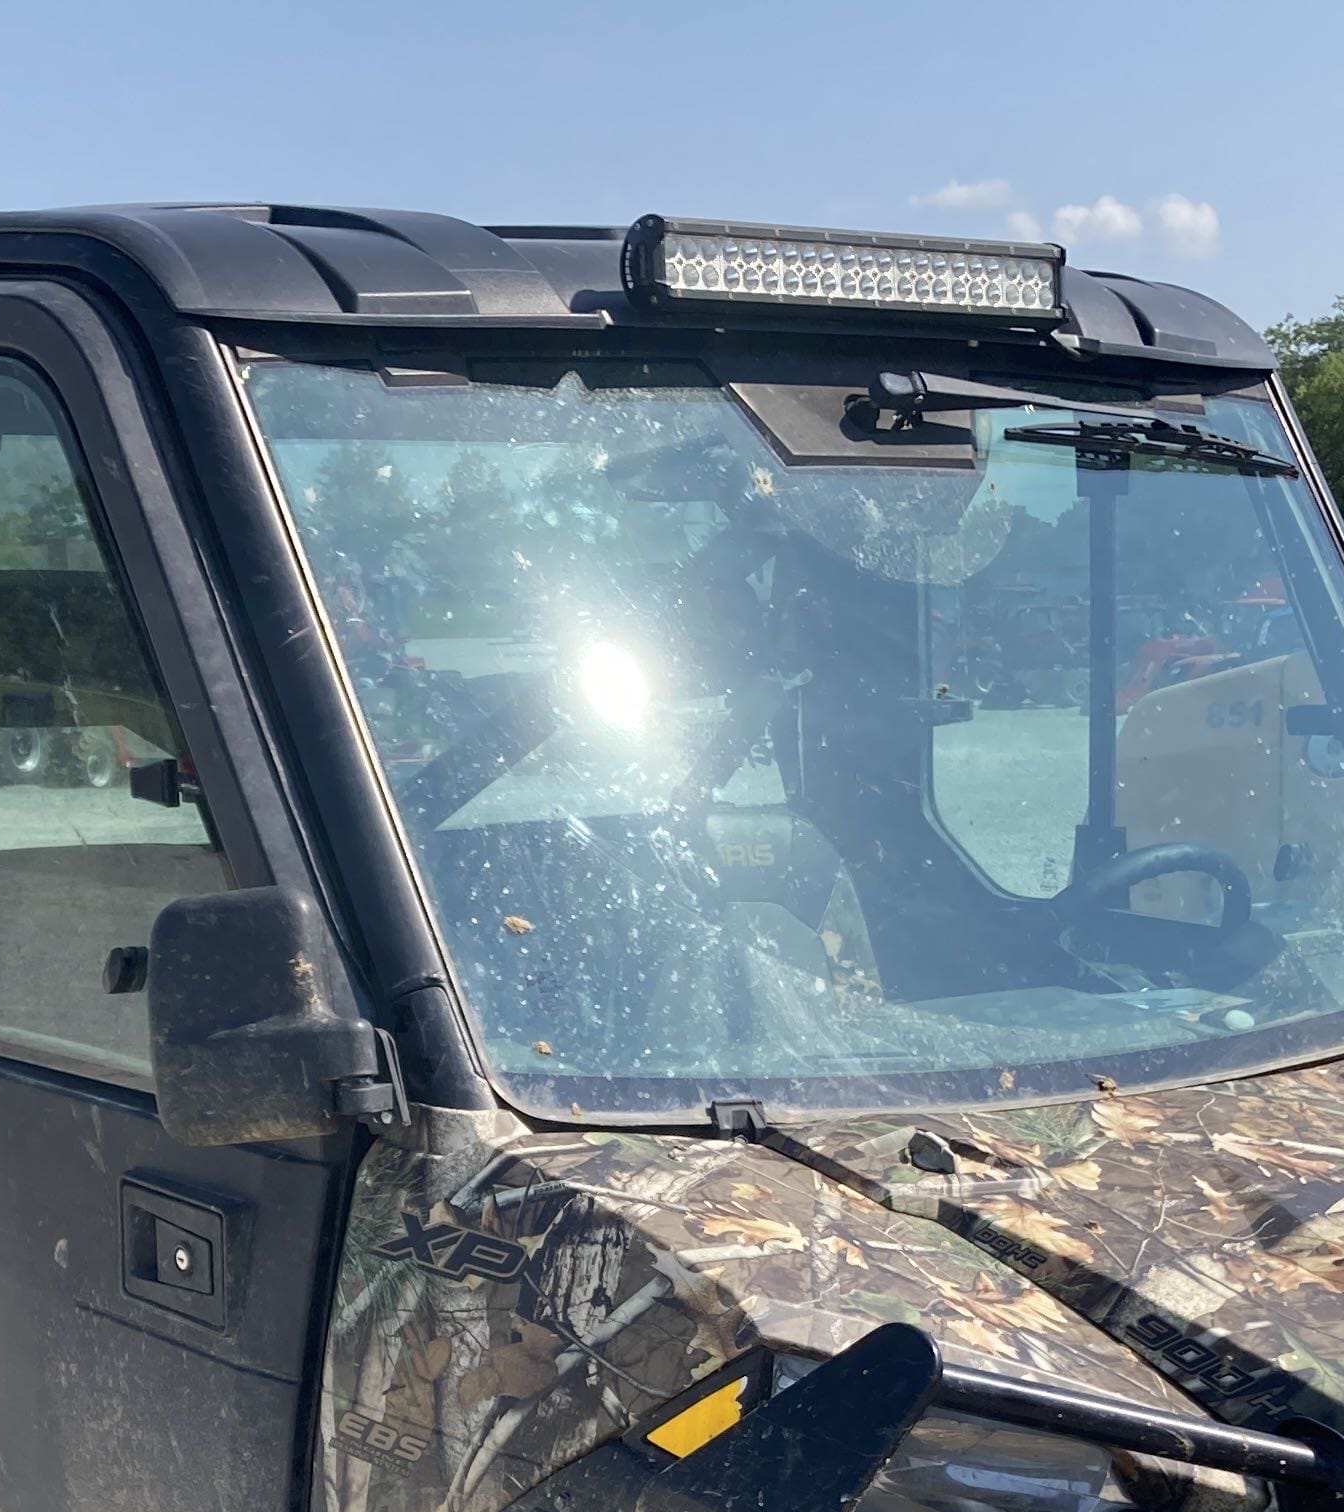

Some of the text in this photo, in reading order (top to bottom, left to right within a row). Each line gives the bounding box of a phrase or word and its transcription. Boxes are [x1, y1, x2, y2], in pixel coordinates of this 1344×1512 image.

[1205, 700, 1264, 729] 851
[371, 1211, 527, 1284] XP
[1125, 1313, 1256, 1395] 900
[1250, 1394, 1288, 1420] H
[338, 1411, 429, 1462] EBS
